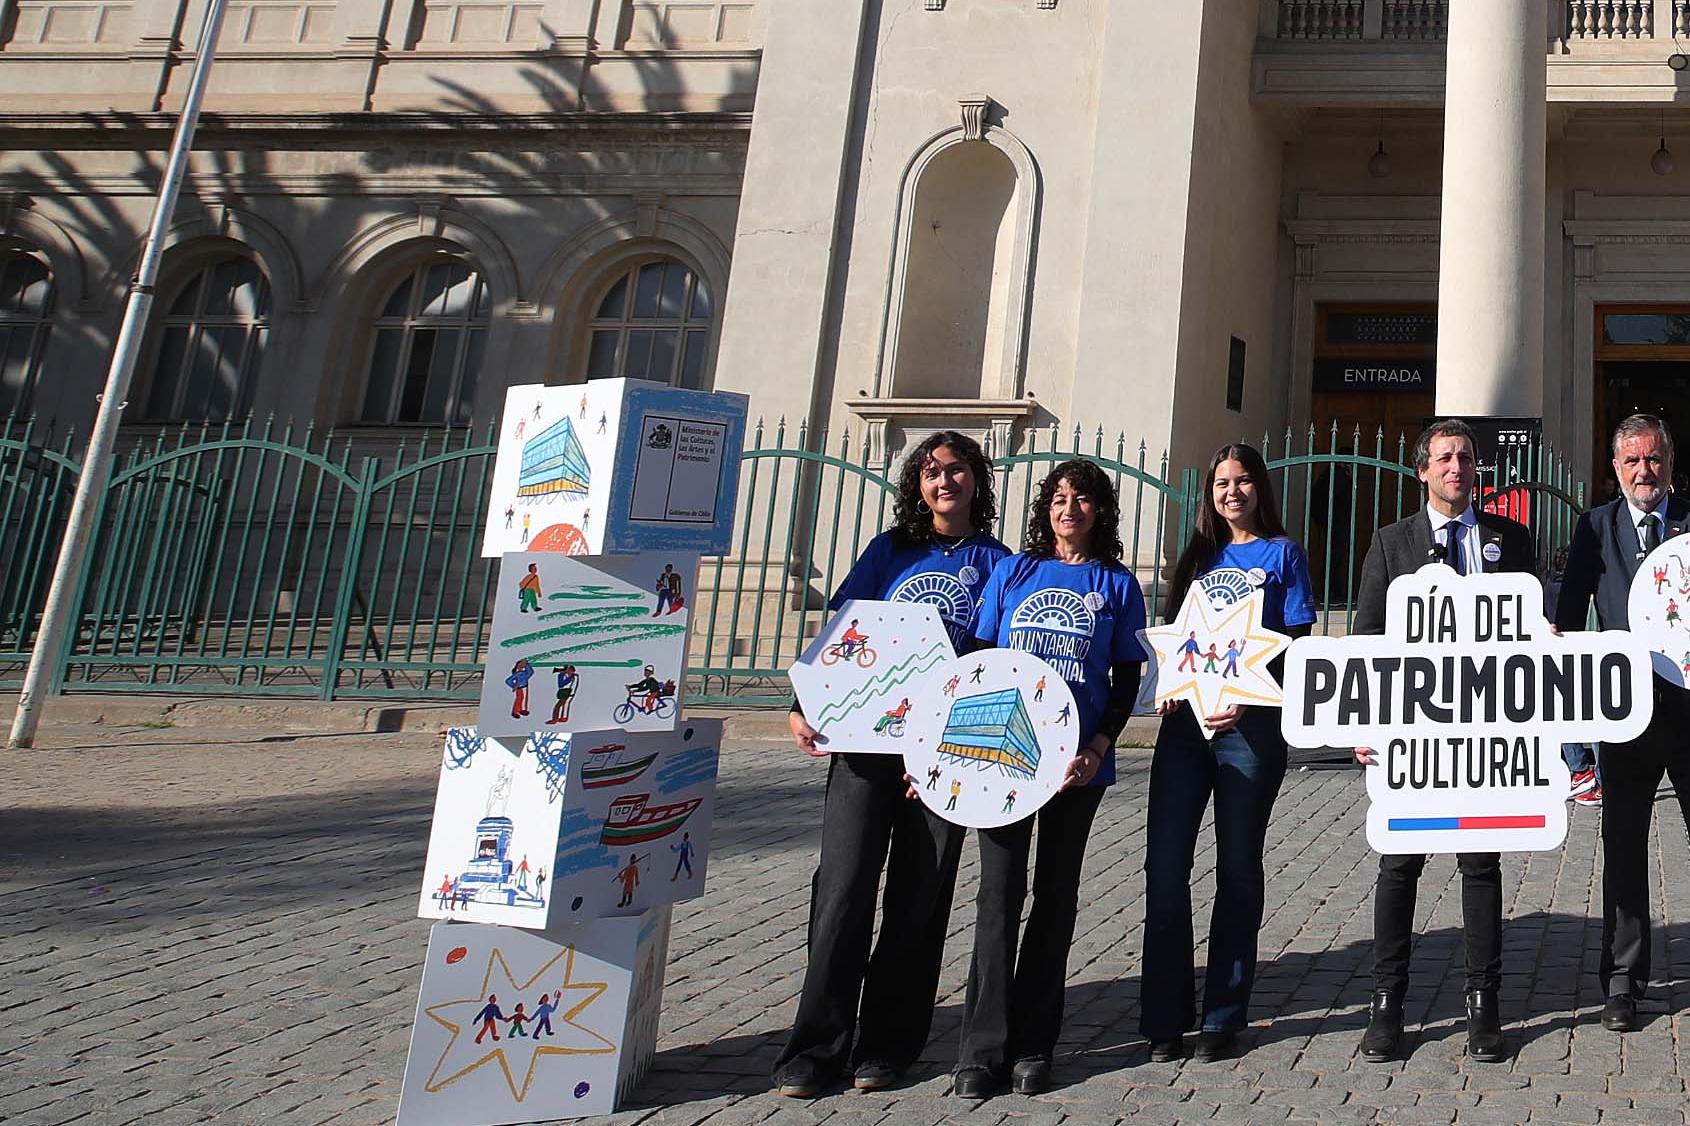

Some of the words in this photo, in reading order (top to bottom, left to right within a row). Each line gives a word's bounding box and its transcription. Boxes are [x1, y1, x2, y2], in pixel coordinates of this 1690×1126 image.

[1344, 369, 1422, 382] ENTRADA
[1405, 585, 1457, 644] DÍA
[1474, 594, 1532, 643] DEL
[1009, 631, 1091, 659] VOLUNTARIADO
[1302, 652, 1633, 726] PATRIMONIO
[1387, 736, 1549, 790] CULTURAL
